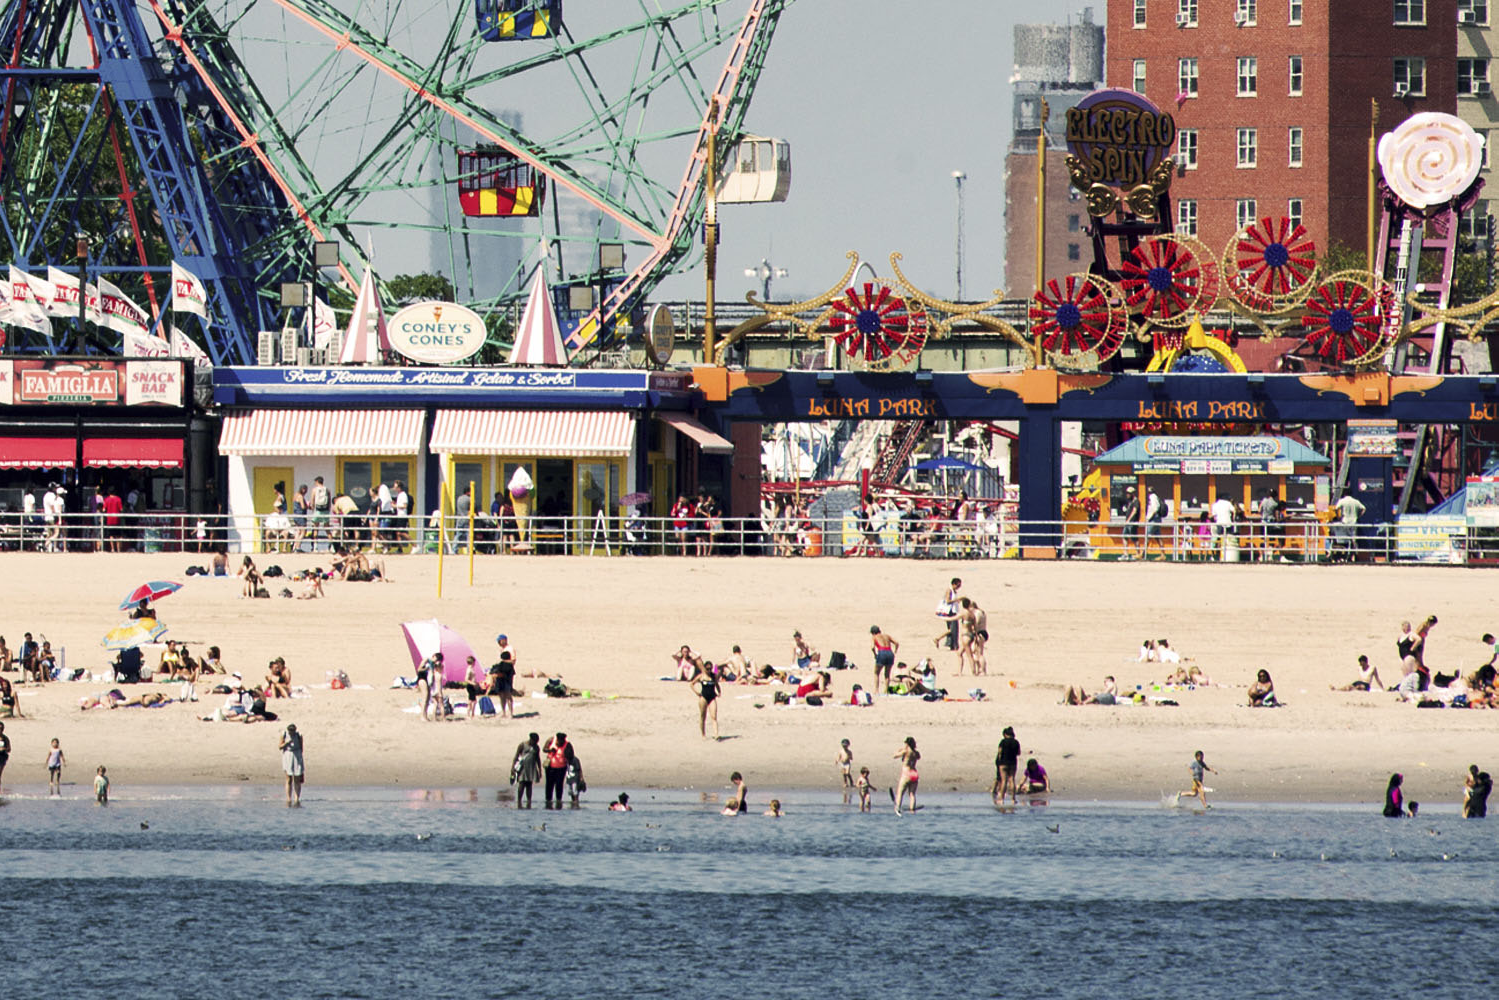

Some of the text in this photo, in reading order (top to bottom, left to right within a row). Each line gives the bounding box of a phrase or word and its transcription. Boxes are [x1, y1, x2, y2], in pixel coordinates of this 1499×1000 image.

[1065, 106, 1176, 147] ELECTRO
[1089, 147, 1146, 183] SPIN
[402, 322, 471, 334] CONEY'S
[409, 335, 464, 345] CONES
[25, 376, 113, 394] FAMIGLIA
[131, 372, 175, 383] SNACK
[285, 369, 327, 383] Fresh
[326, 370, 404, 385] Homemade
[471, 372, 515, 386] Gelato
[516, 374, 526, 385] &
[526, 372, 574, 386] Sorbet
[141, 383, 167, 393] BAR
[808, 398, 938, 416] LUNA PARK
[1138, 400, 1267, 419] LUNA PARK
[1153, 440, 1275, 456] LUNA PARK TICKETS
